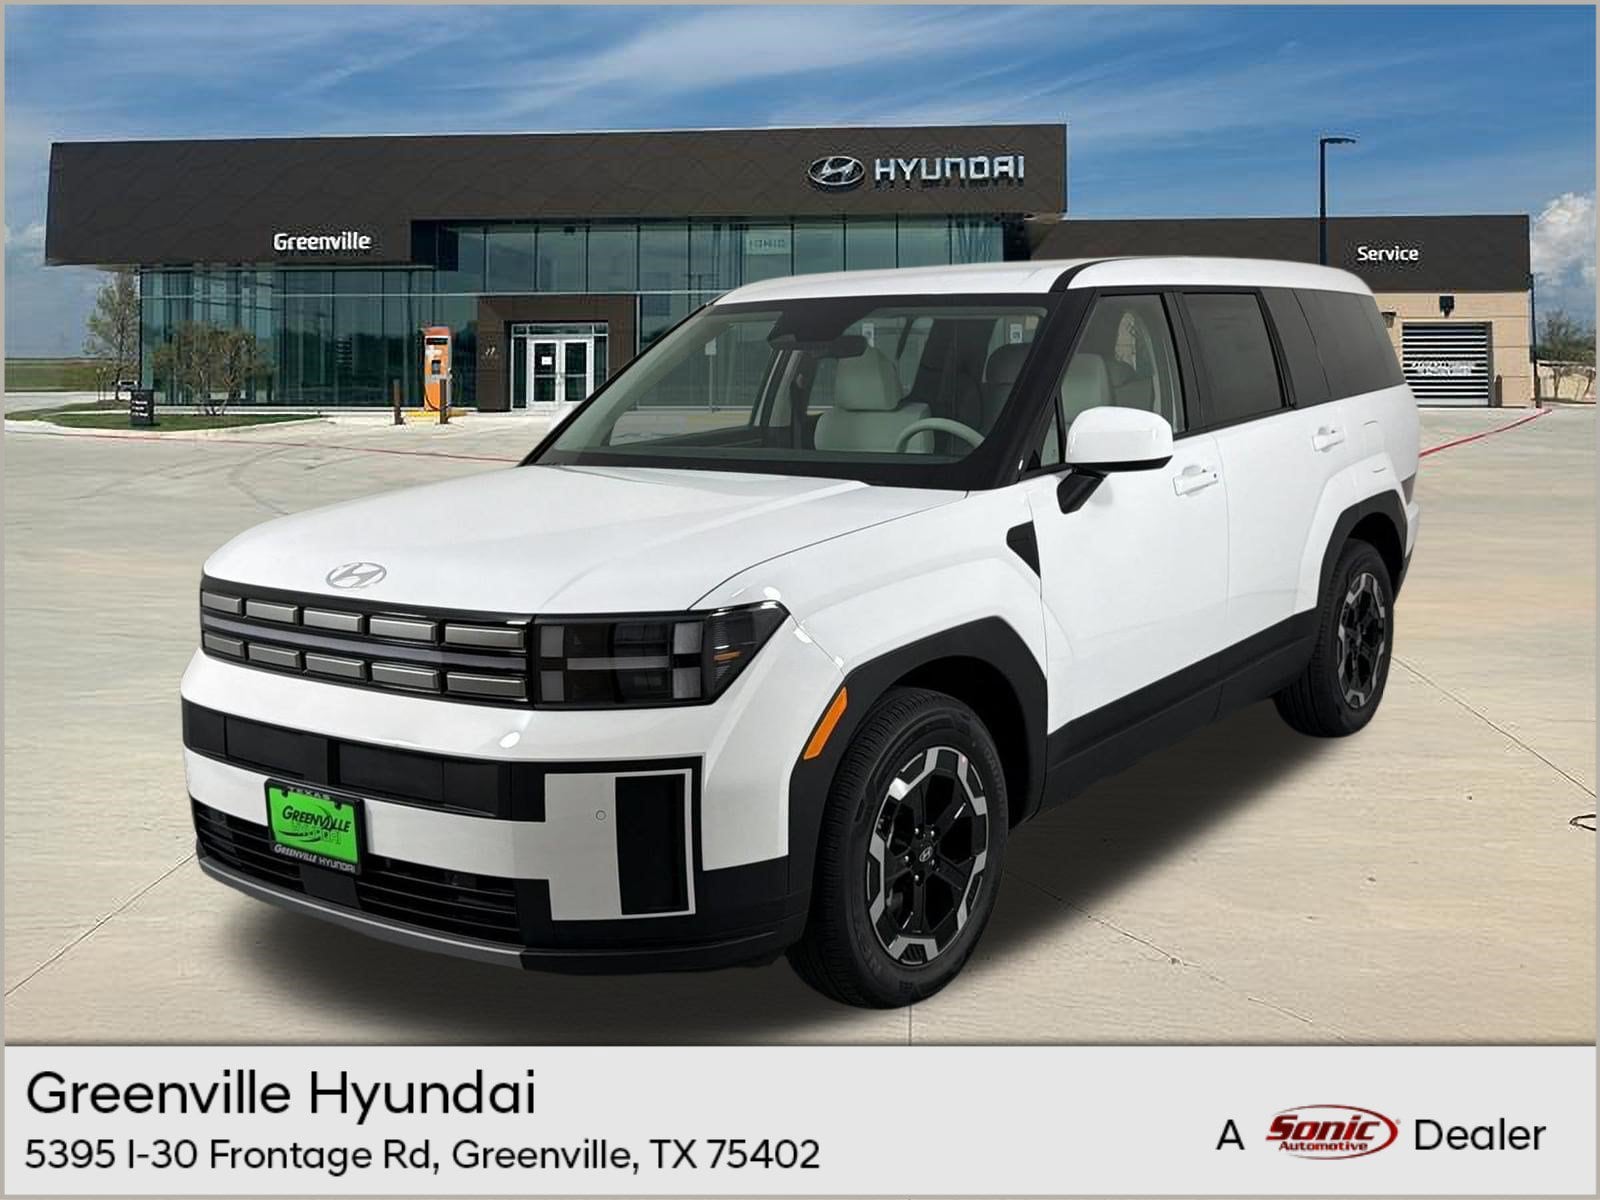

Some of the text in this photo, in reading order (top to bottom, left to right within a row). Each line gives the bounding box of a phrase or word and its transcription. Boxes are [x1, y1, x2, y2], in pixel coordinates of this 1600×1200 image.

[875, 156, 1025, 181] HYUNDAI
[273, 231, 372, 251] Greenville
[1357, 245, 1419, 261] Service
